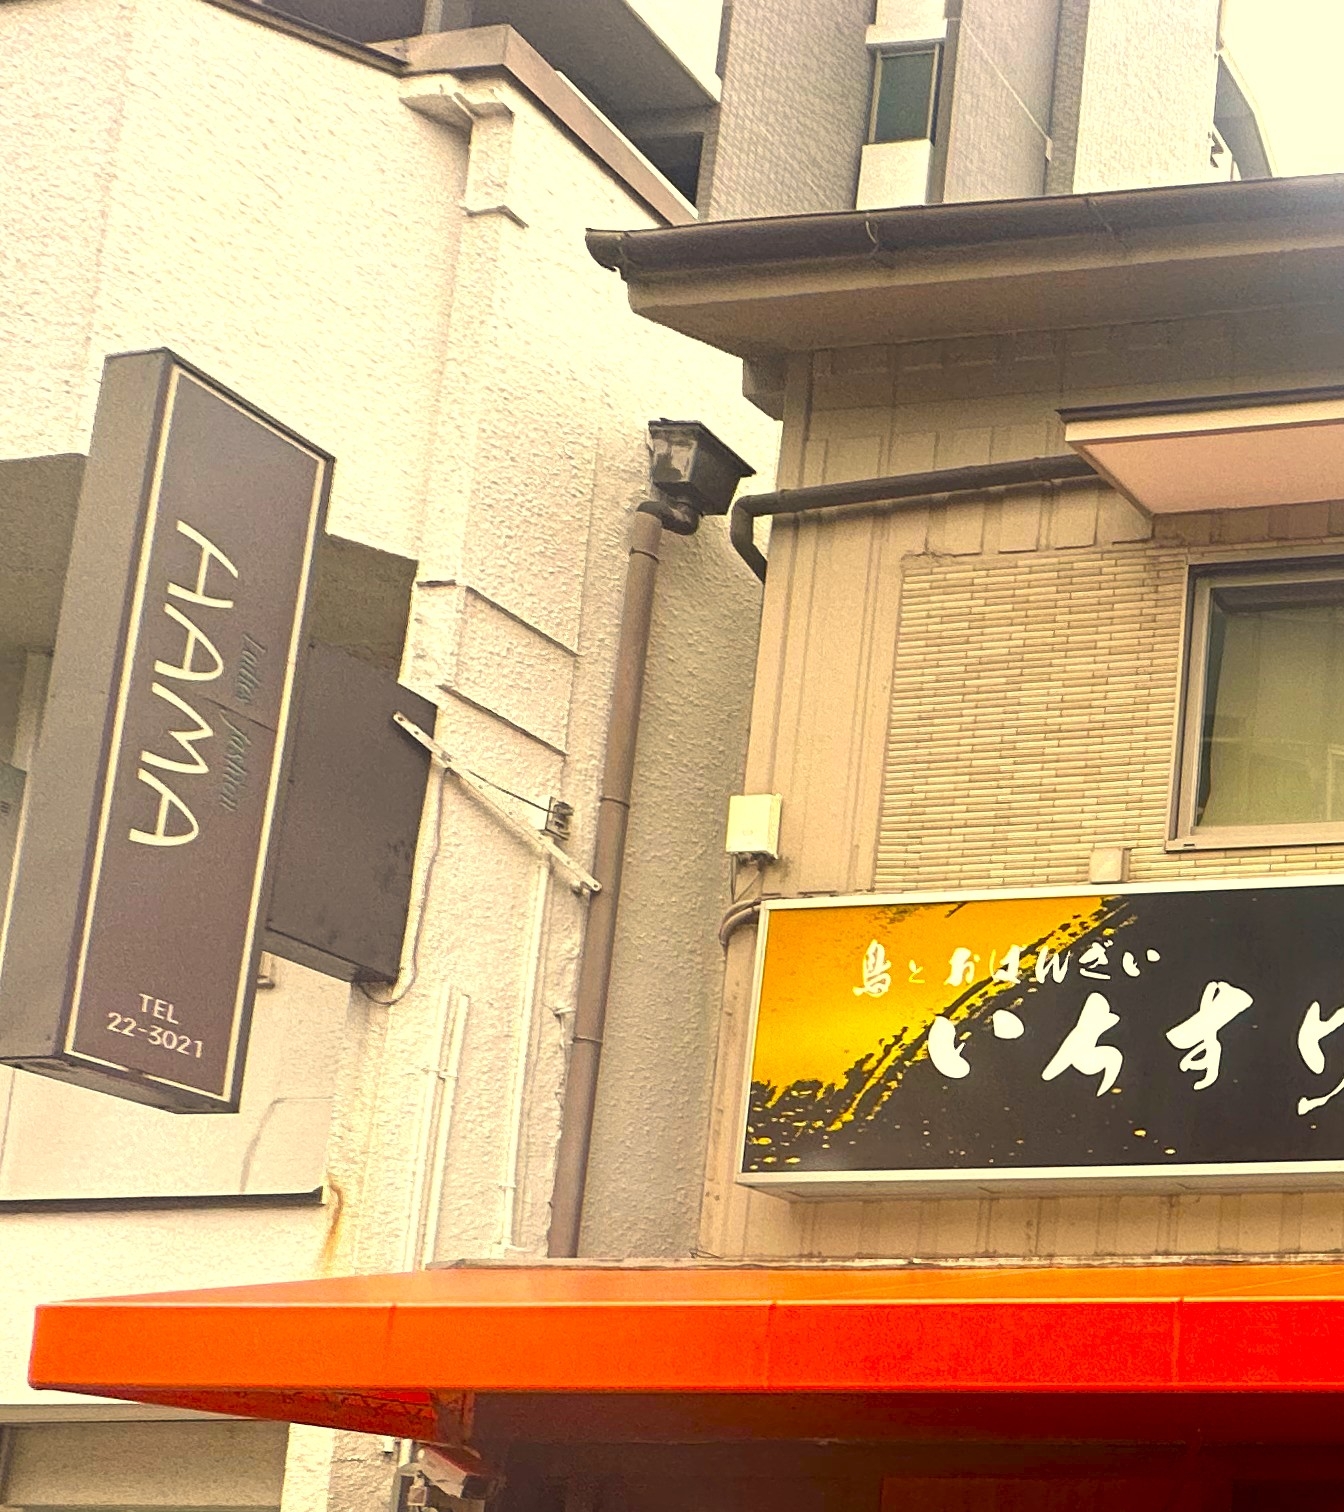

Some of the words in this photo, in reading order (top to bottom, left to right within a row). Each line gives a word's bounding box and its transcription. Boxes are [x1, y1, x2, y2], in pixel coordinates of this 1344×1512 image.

[128, 518, 240, 848] HAMA
[138, 991, 181, 1026] TEL
[106, 1011, 205, 1060] 22-3021
